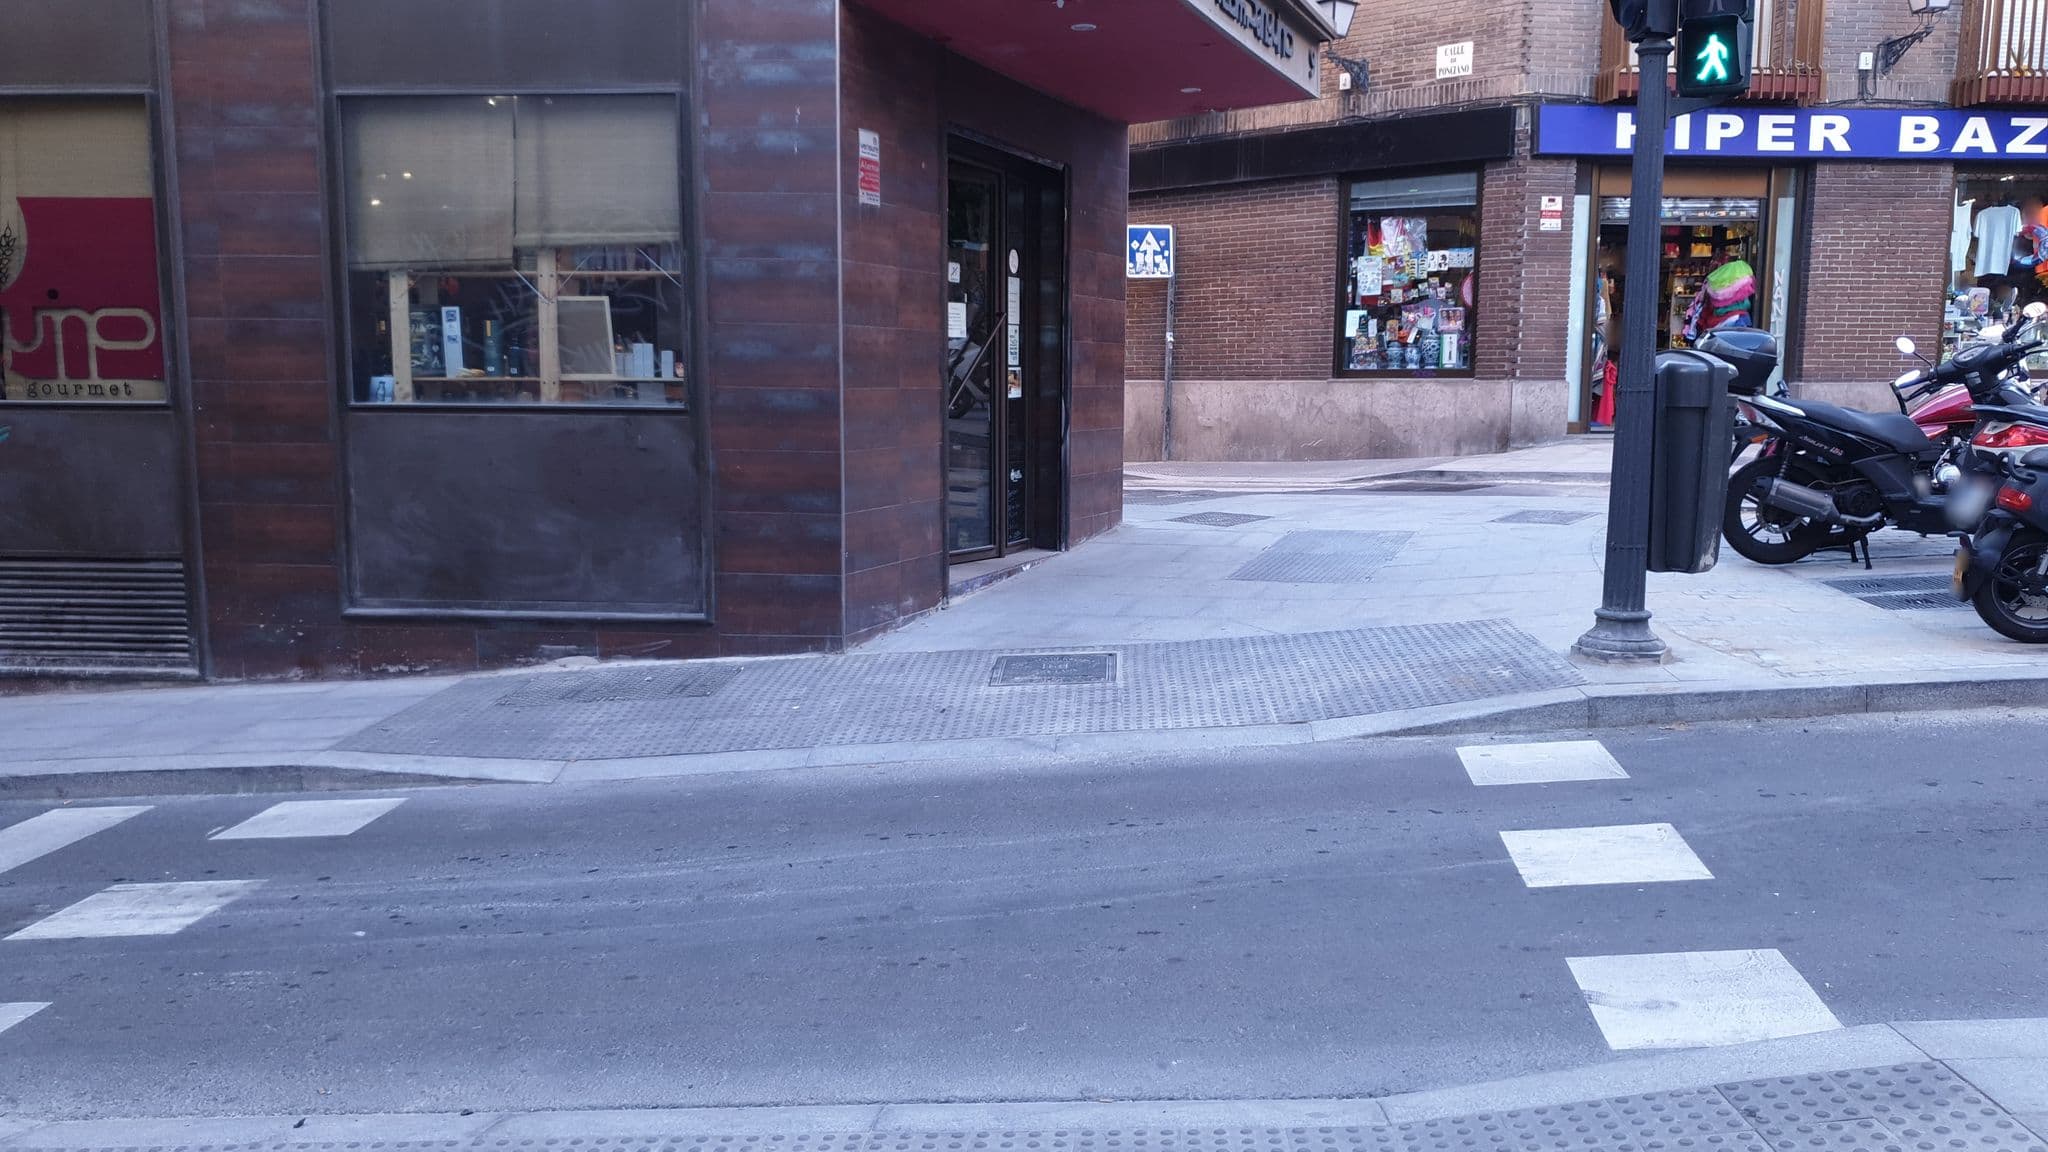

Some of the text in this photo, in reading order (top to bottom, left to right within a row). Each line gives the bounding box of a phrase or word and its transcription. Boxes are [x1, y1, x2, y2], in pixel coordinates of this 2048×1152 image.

[1444, 45, 1465, 56] CALLE
[1898, 115, 2048, 154] BAZ
[26, 380, 133, 398] gourmet
